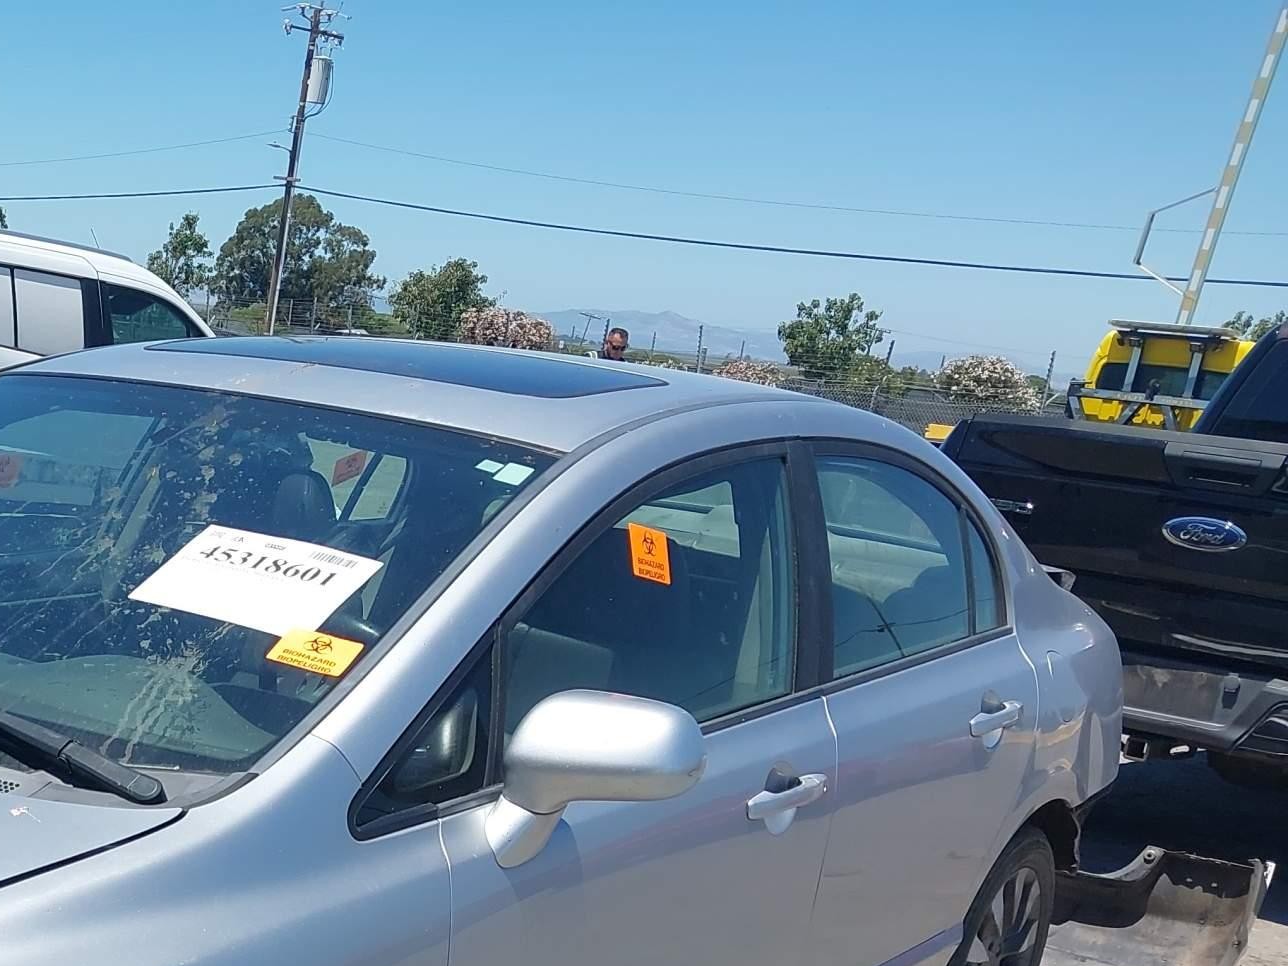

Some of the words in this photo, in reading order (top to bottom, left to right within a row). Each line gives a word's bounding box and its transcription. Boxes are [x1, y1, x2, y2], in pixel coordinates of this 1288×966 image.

[1180, 522, 1227, 545] Ford
[199, 545, 337, 587] 45318601
[276, 655, 332, 673] BIOPELIGRO
[283, 648, 337, 668] BIOHAZARD
